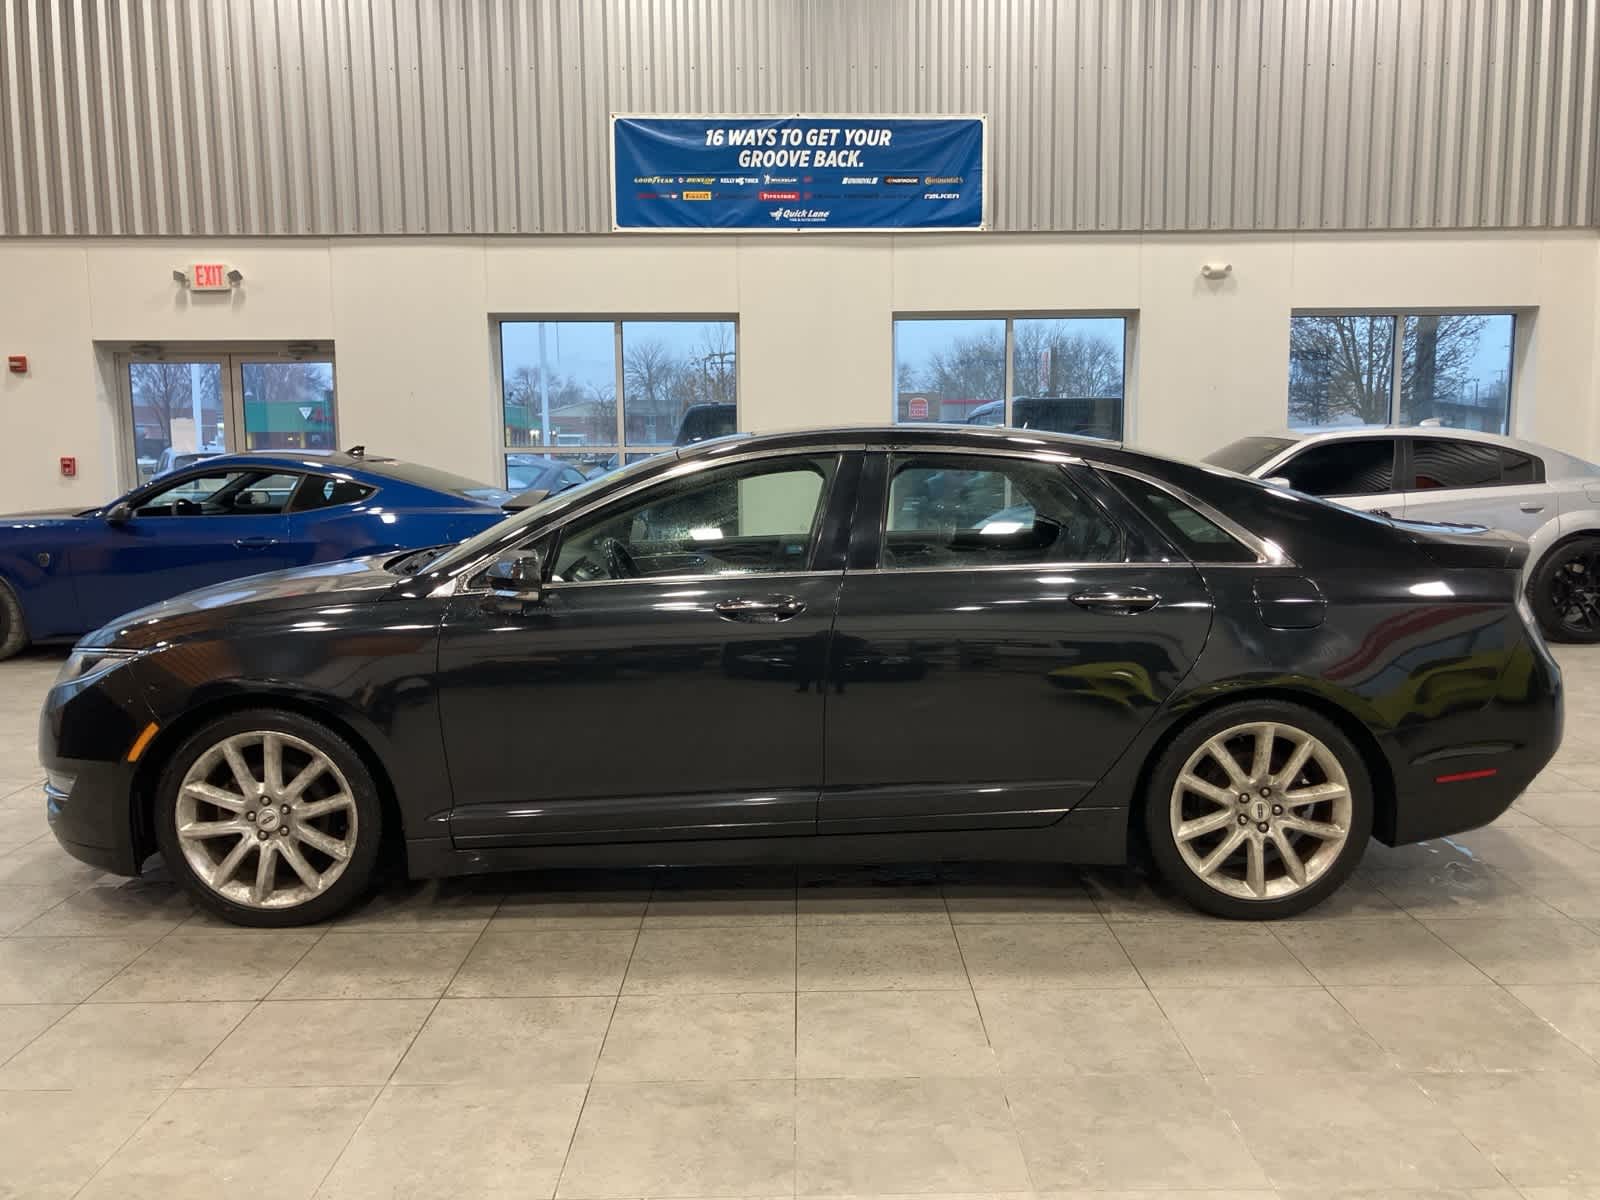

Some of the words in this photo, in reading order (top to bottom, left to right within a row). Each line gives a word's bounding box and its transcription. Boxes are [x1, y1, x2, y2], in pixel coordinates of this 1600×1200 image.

[705, 129, 724, 146] 16
[728, 129, 777, 146] WAYS
[780, 129, 803, 146] TO
[805, 129, 840, 146] GET
[844, 129, 893, 146] YOUR
[738, 150, 811, 167] GROOVE
[813, 150, 864, 167] BACK.
[783, 209, 807, 218] Quick
[808, 209, 830, 218] Lane
[195, 264, 224, 287] EXIT
